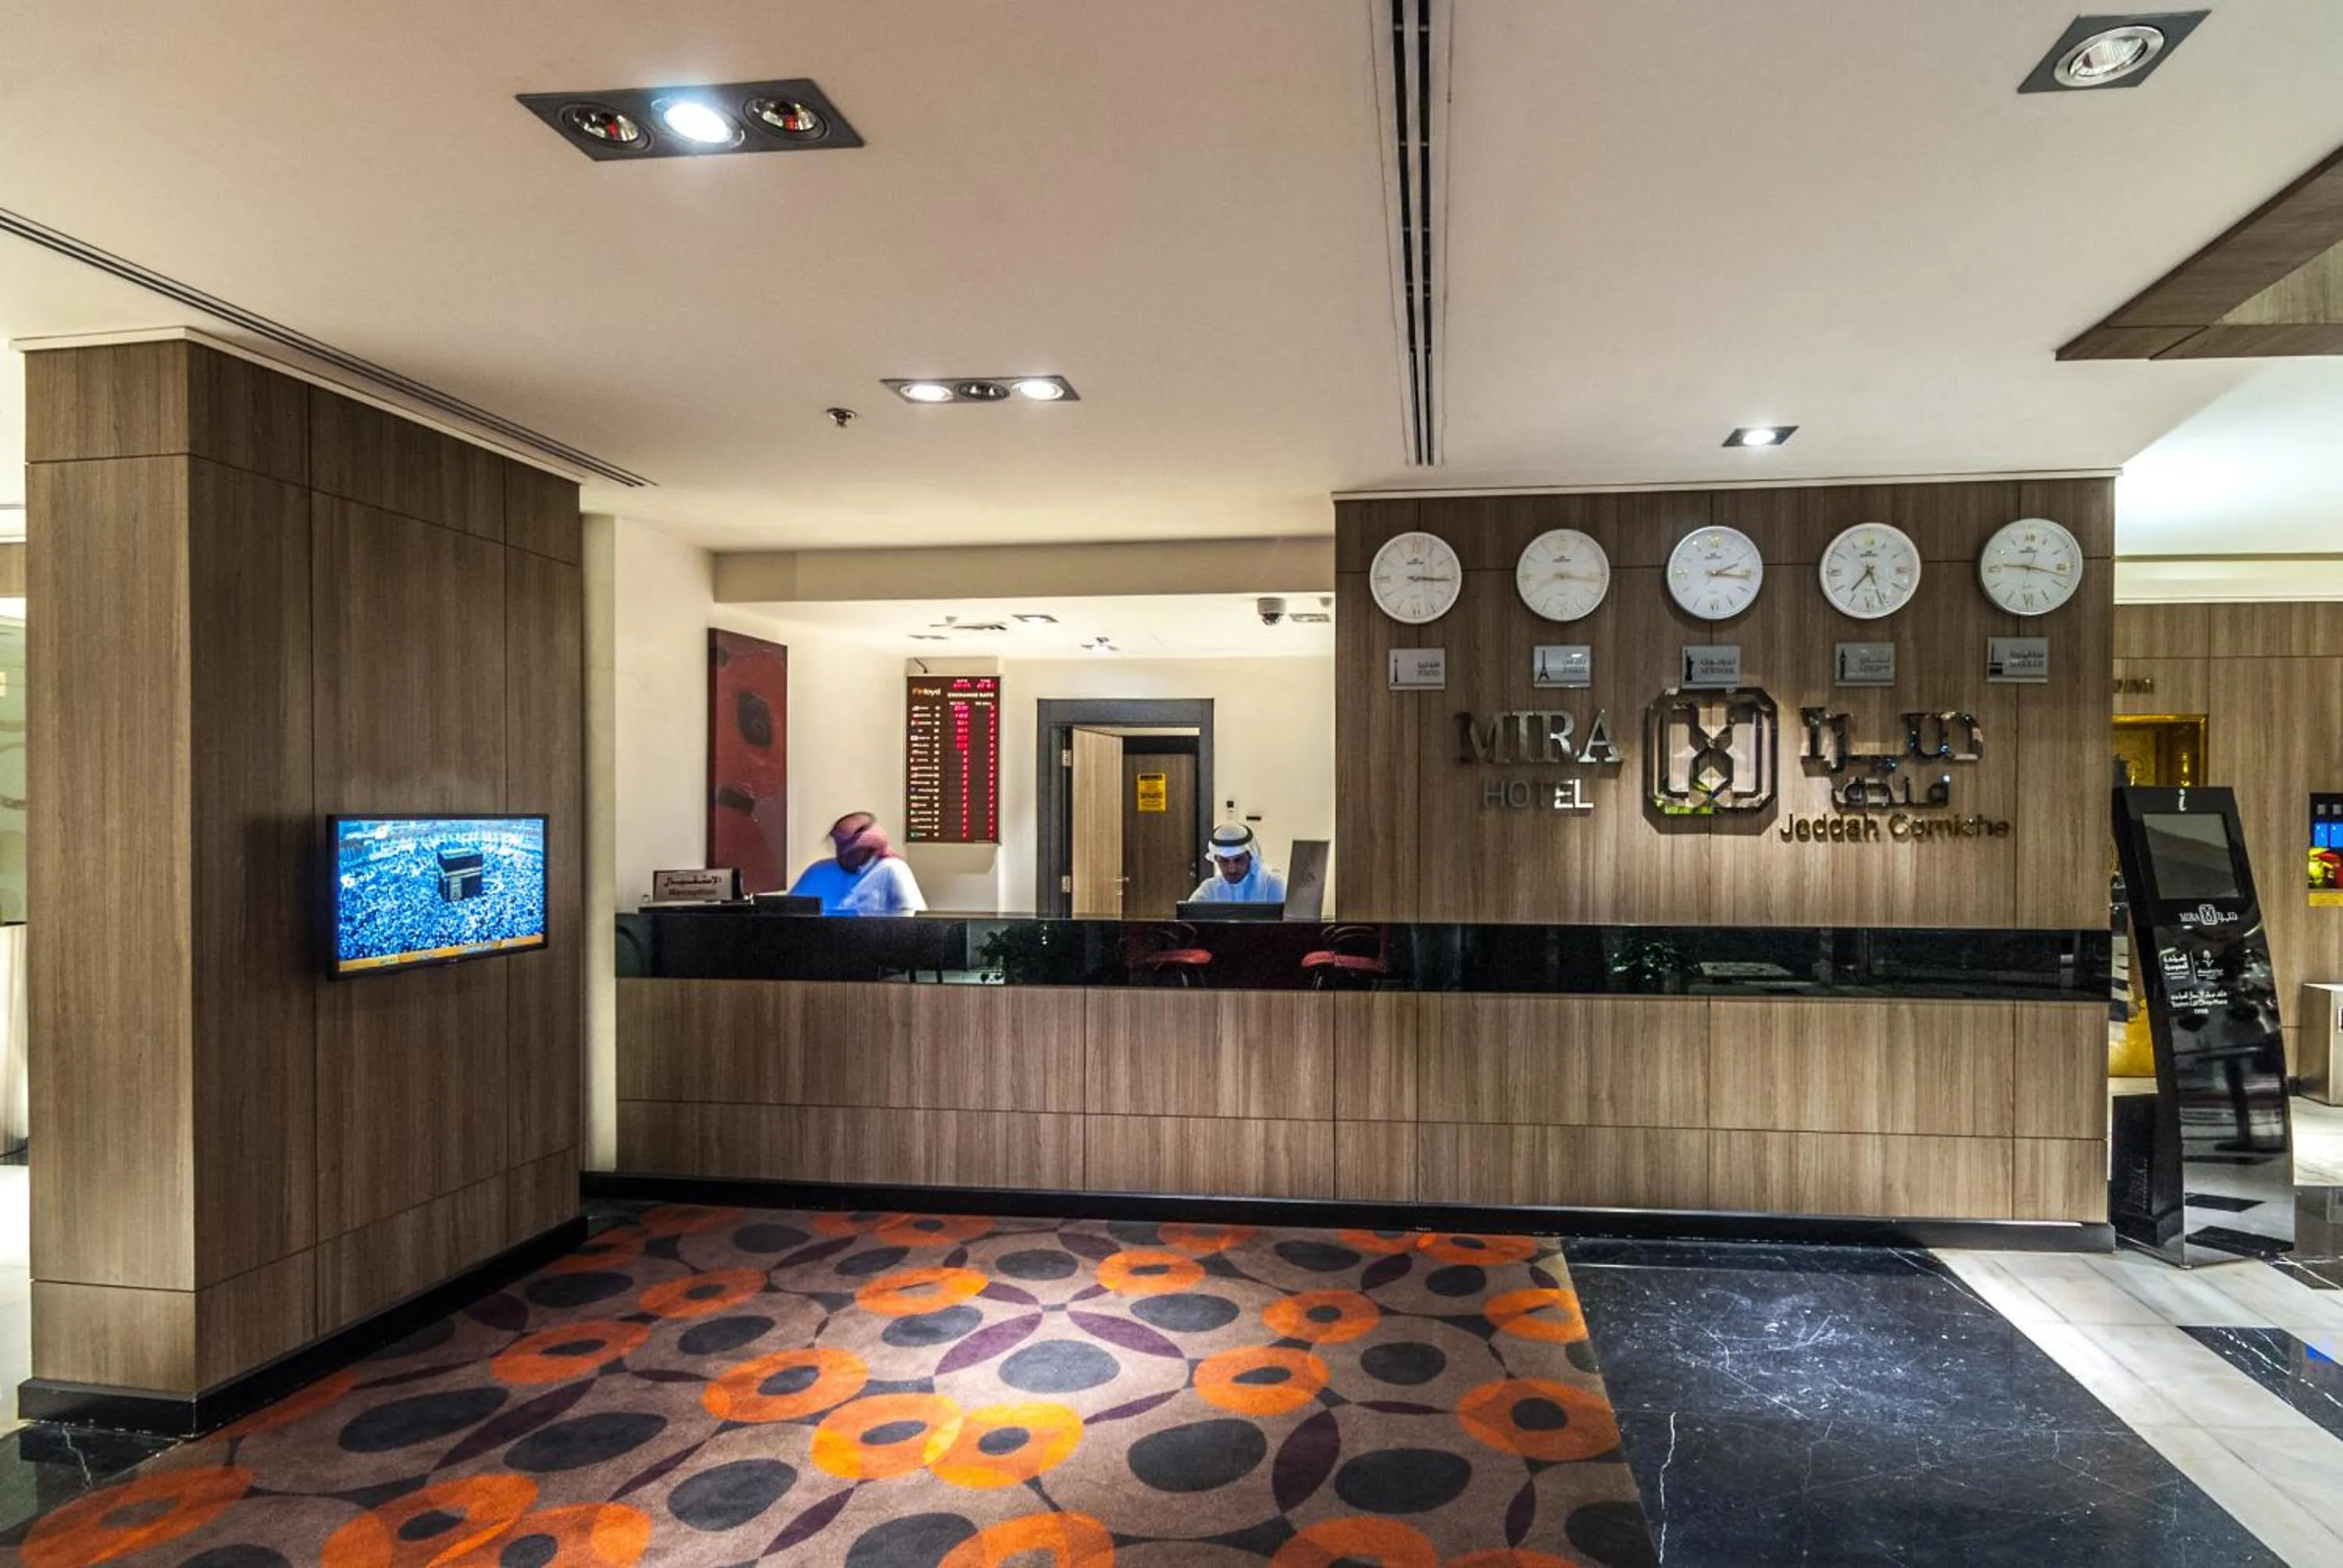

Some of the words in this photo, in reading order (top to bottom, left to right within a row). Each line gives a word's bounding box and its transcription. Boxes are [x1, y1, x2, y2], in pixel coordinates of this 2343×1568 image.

[1453, 708, 1622, 765] MIRA
[1484, 779, 1594, 810] HOTEL
[1780, 813, 1880, 843] Jeddah
[1888, 813, 2012, 842] Corniche
